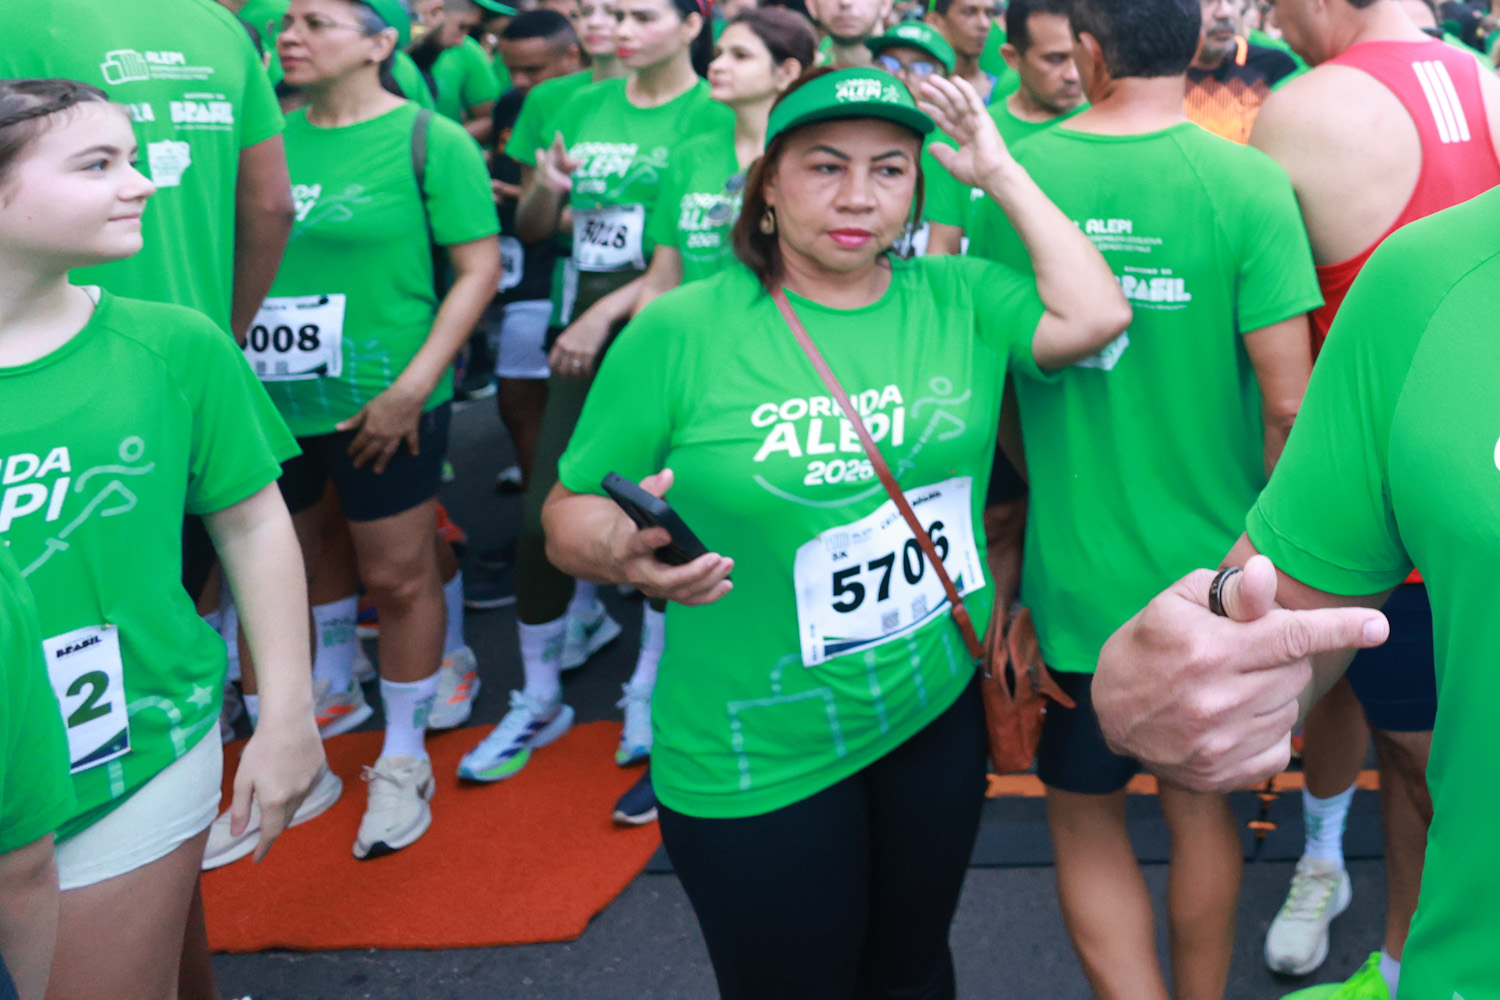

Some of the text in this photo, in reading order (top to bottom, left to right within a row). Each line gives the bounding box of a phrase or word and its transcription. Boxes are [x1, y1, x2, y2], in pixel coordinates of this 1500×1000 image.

[1086, 218, 1132, 234] ALEPI
[245, 323, 320, 353] 008
[803, 459, 875, 486] 2026
[832, 520, 949, 613] 5706
